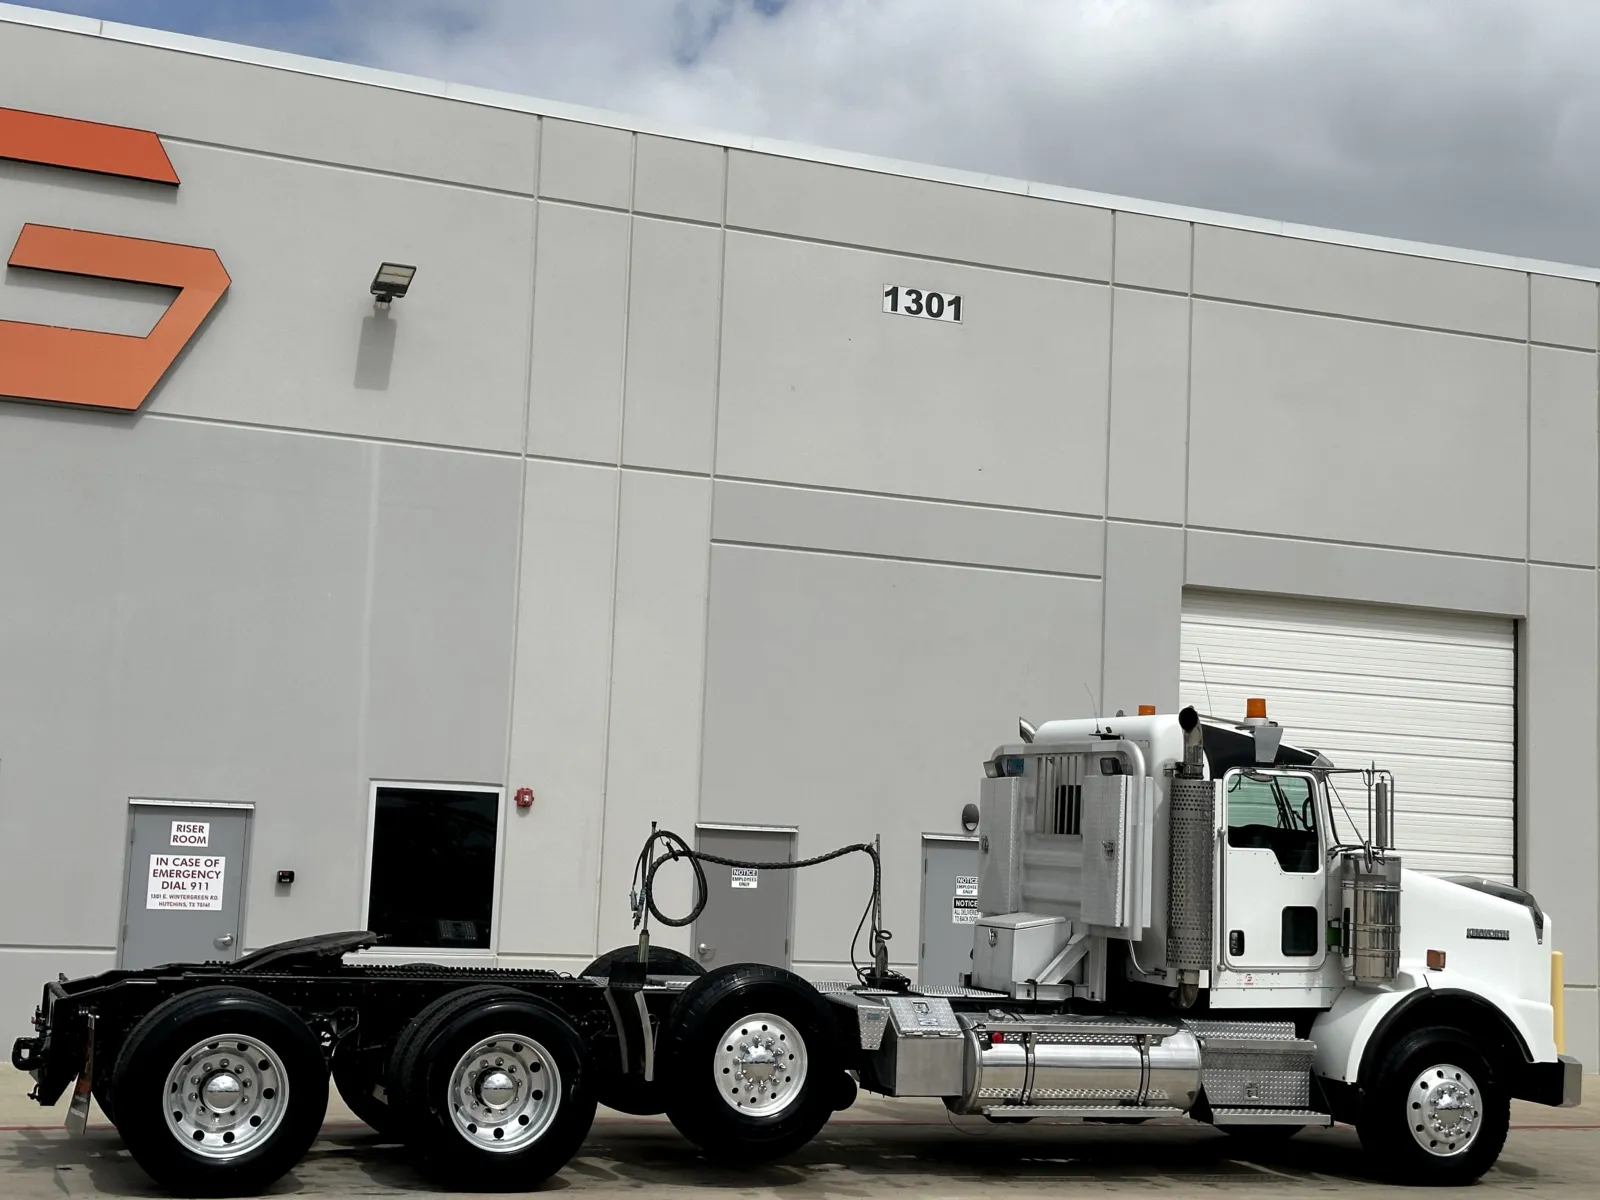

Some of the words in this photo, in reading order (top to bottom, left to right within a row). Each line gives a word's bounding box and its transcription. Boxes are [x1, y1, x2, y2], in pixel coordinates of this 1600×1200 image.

[885, 286, 961, 321] 1301
[176, 824, 205, 834] RISER
[172, 835, 207, 844] ROOM
[156, 857, 169, 866] IN
[172, 858, 201, 867] CASE
[204, 859, 220, 868] OF
[152, 869, 222, 880] EMERGENCY
[161, 881, 187, 890] DIAL
[190, 882, 209, 891] 911
[955, 899, 978, 907] NOTICE
